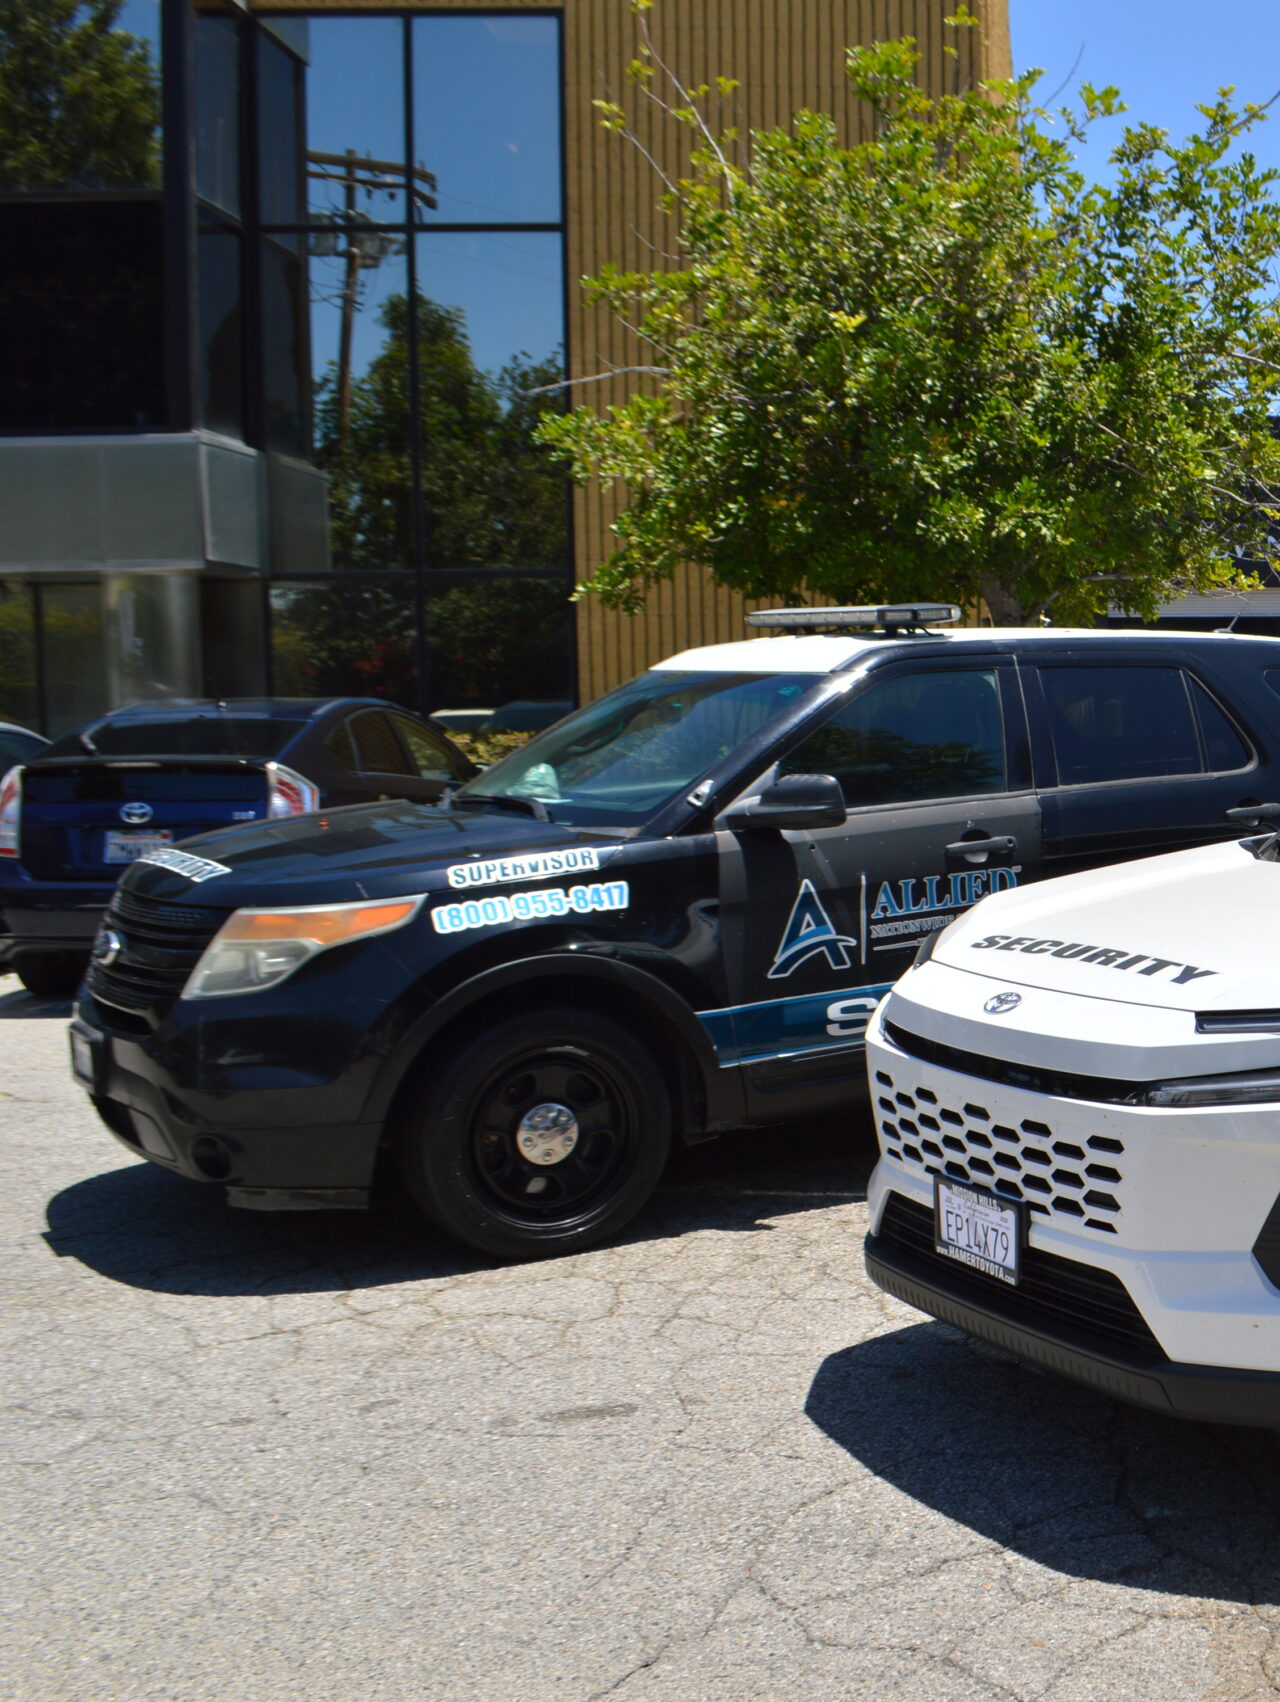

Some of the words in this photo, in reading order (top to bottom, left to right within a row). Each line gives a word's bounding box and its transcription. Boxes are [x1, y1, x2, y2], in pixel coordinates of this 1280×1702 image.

[452, 849, 595, 885] SUPERVISOR
[435, 900, 509, 931] (800)
[513, 884, 628, 917] 955-8417
[970, 934, 1219, 985] SECURITY
[951, 1183, 978, 1204] MISSION
[946, 1209, 1009, 1263] EP14X79
